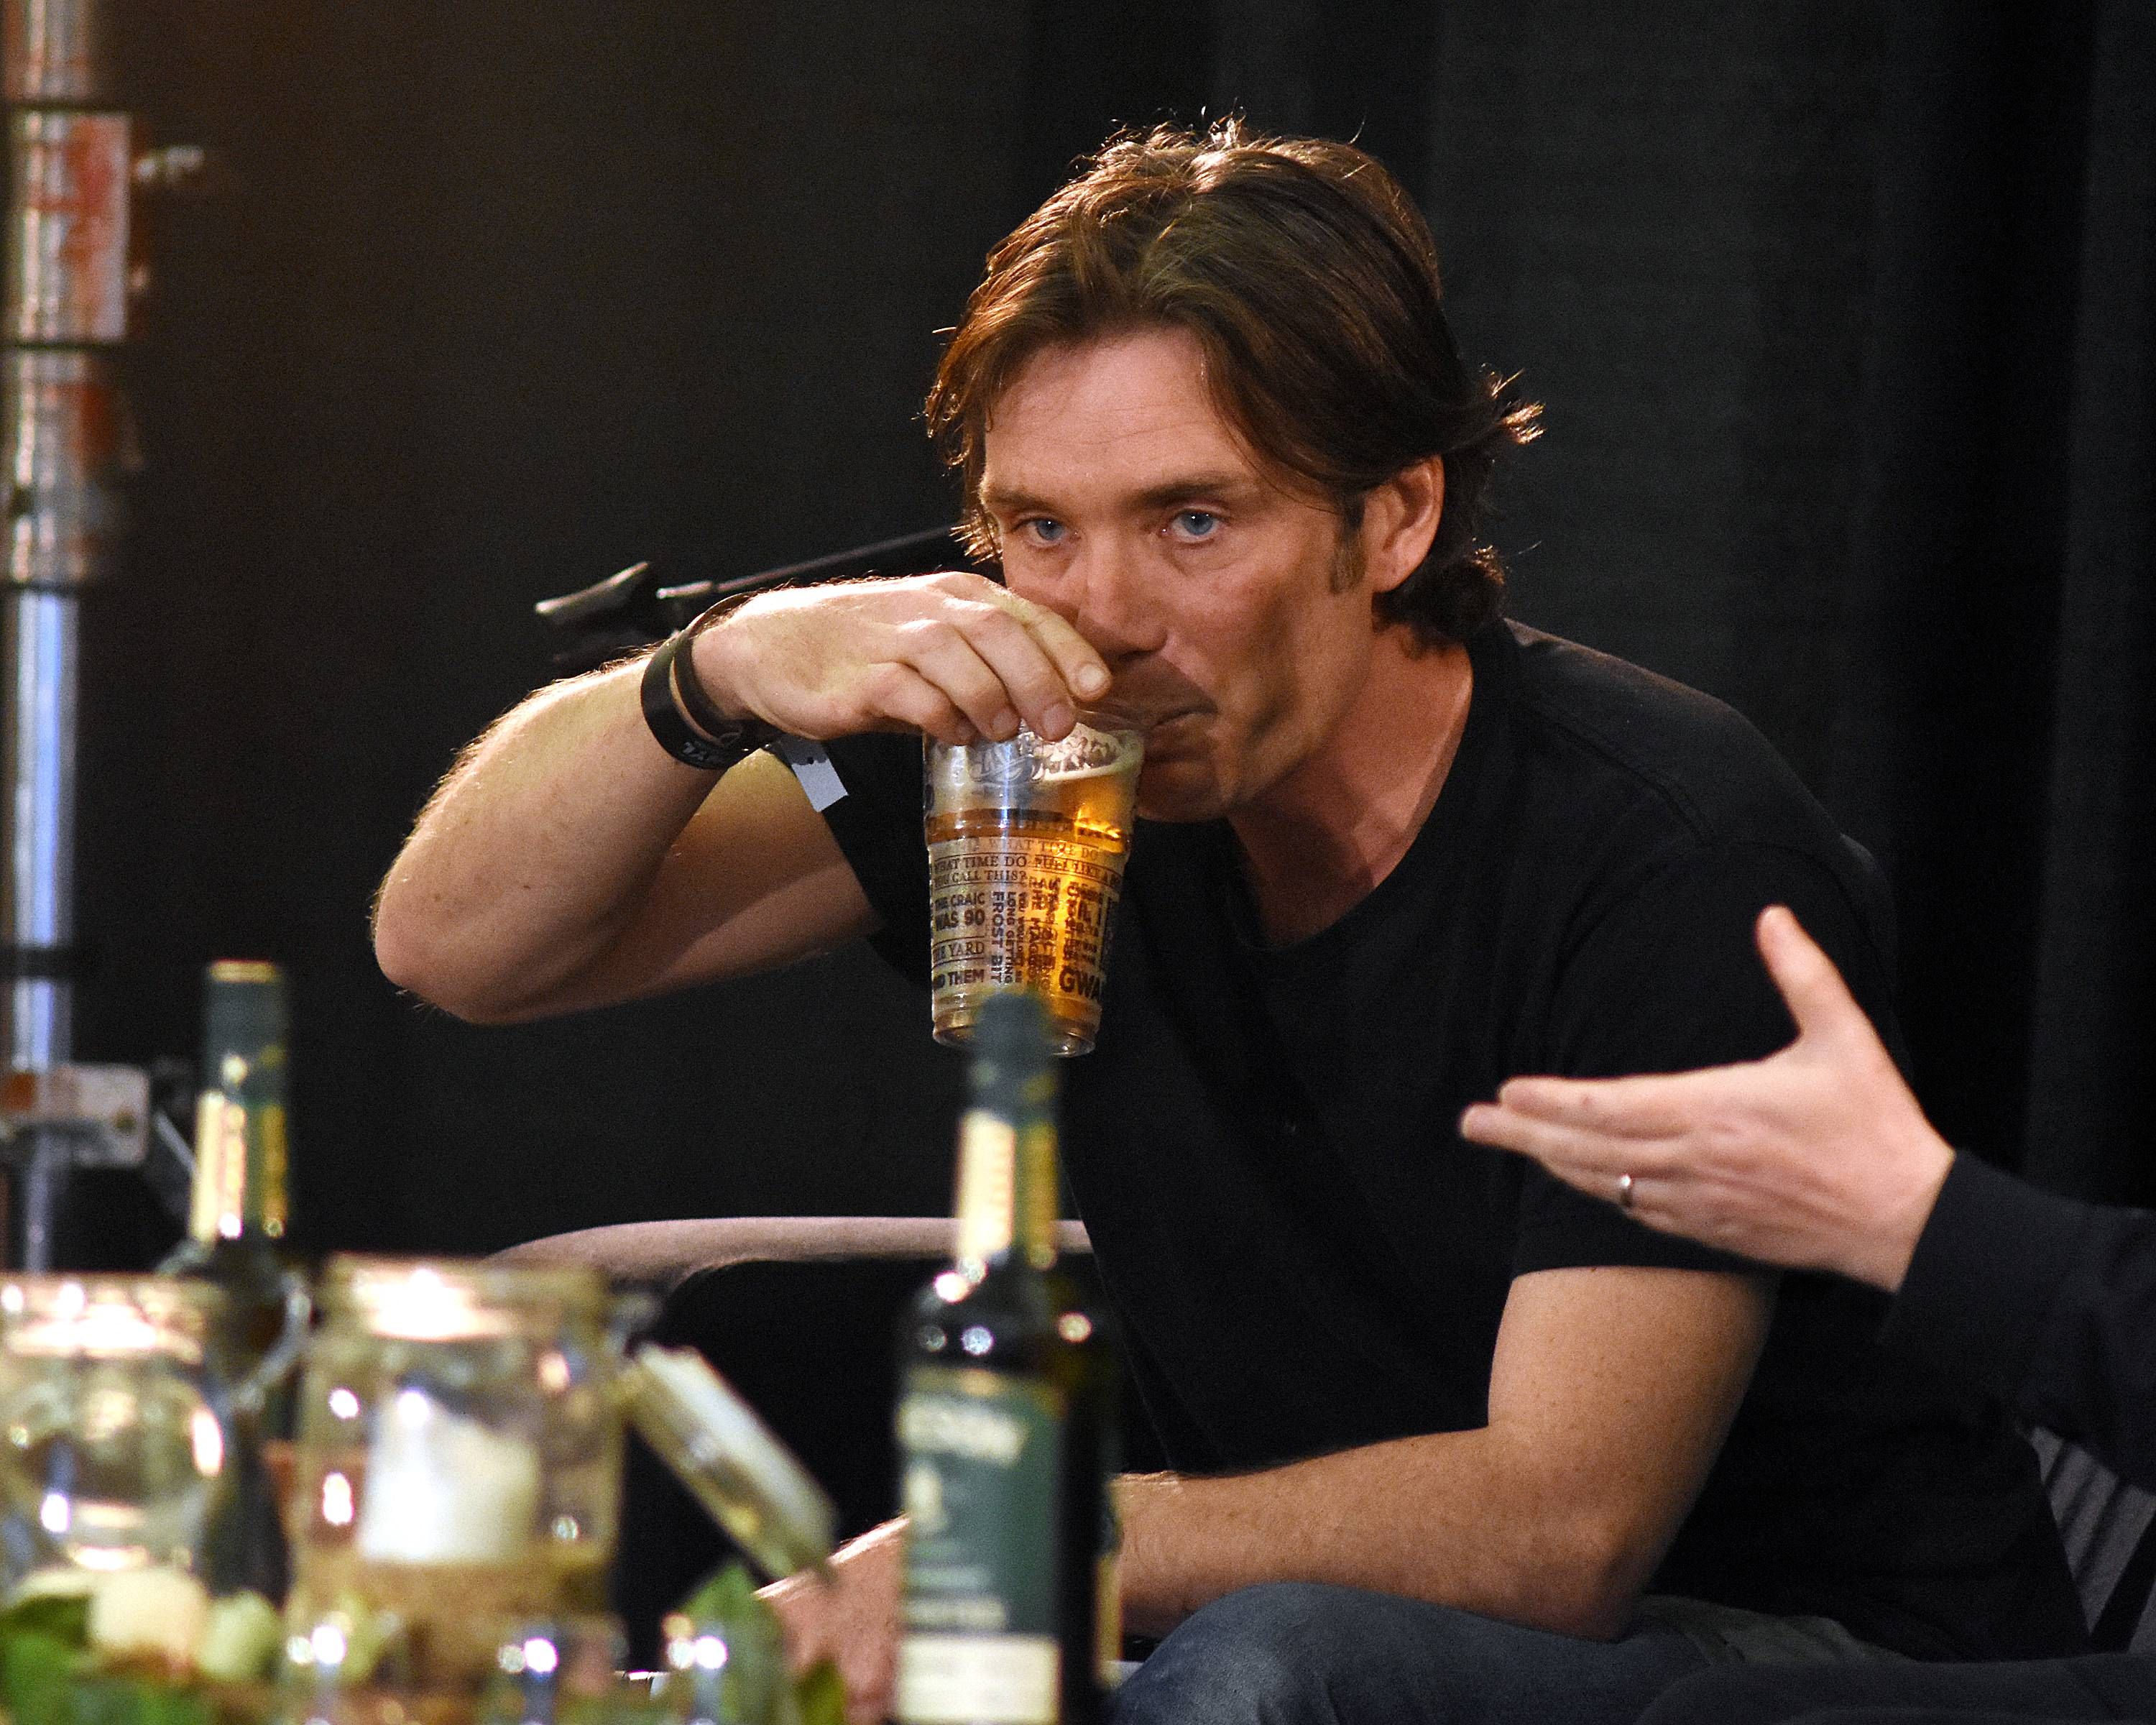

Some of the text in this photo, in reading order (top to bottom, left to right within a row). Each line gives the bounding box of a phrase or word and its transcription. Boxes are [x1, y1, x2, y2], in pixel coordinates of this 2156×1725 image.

[964, 855, 998, 868] TIME
[1004, 855, 1027, 868] DO
[985, 869, 1026, 881] THIS?
[949, 891, 986, 907] CRAIC
[964, 908, 985, 926] 90
[991, 891, 1005, 984] FROST BIT
[1005, 891, 1016, 984] LONG GETTING
[947, 941, 985, 957] YARD
[947, 968, 985, 985] THEM
